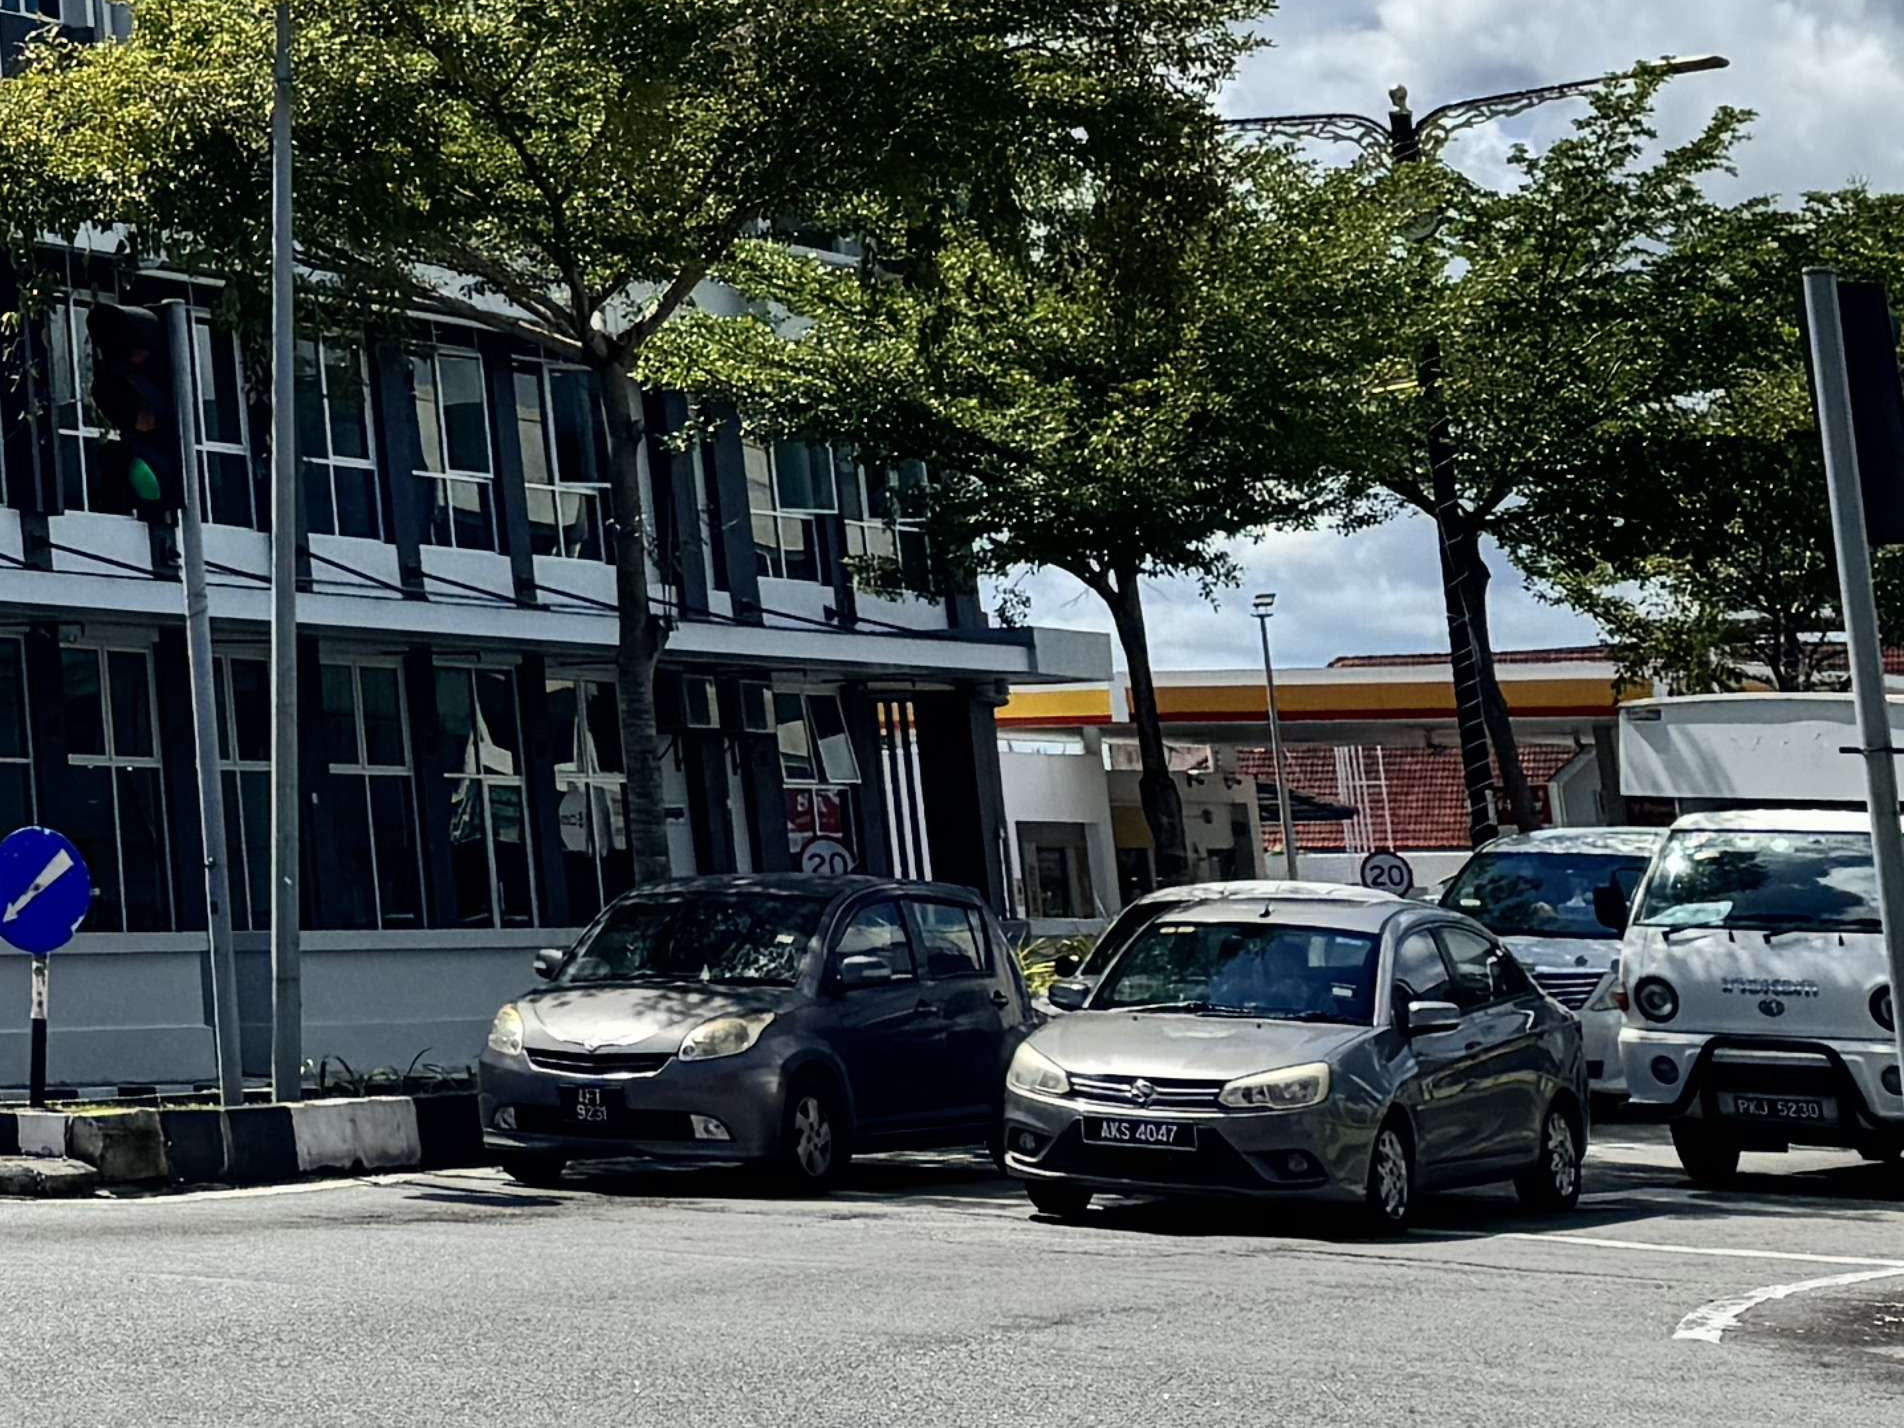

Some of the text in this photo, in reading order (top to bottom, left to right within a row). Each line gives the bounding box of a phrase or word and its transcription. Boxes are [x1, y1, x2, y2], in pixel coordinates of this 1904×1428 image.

[807, 851, 849, 875] 20
[1368, 864, 1405, 887] 20
[1737, 1099, 1820, 1119] PKJ 5230
[1100, 1119, 1179, 1144] AKS 4047
